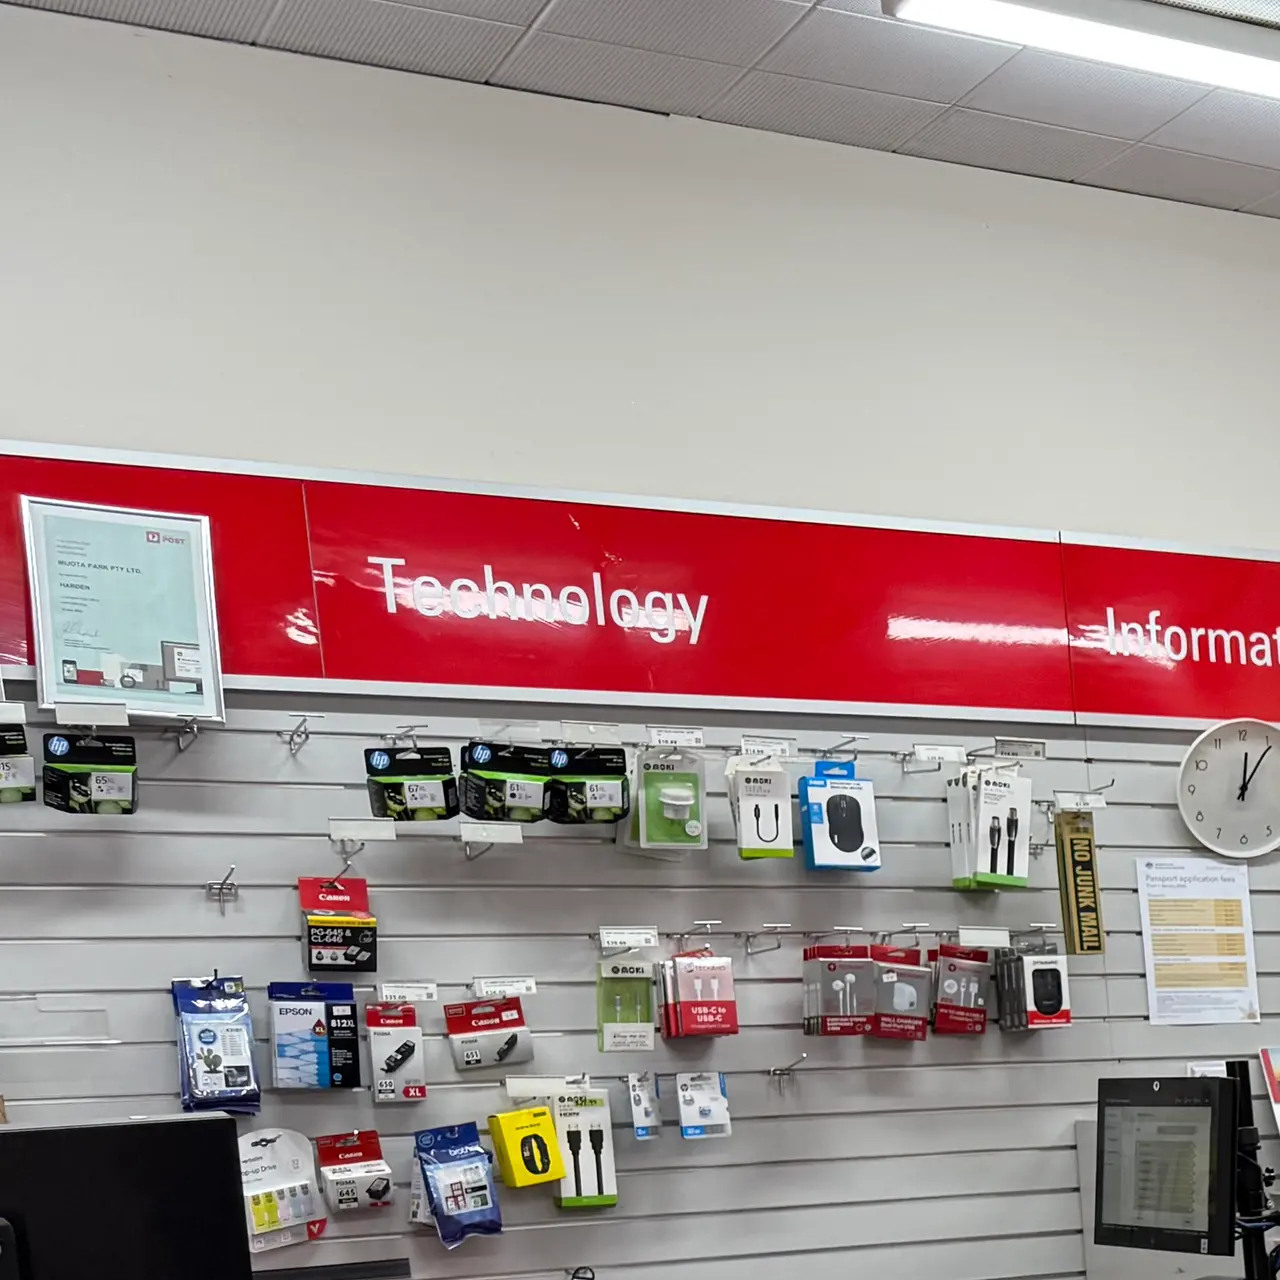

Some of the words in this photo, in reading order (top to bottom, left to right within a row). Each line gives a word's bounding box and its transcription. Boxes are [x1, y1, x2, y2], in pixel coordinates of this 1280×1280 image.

[367, 555, 709, 645] Technology
[1238, 730, 1248, 742] 12
[1265, 735, 1270, 745] 1
[1214, 738, 1222, 750] 11
[1195, 760, 1208, 772] 10
[1188, 784, 1195, 796] 9
[1195, 811, 1204, 822] 8
[1216, 827, 1222, 839] 7
[1266, 825, 1272, 837] 5
[1239, 834, 1248, 845] 6
[1072, 838, 1092, 861] NO
[1146, 874, 1177, 883] Passport
[1179, 874, 1218, 884] application
[1220, 874, 1235, 882] fees
[1075, 863, 1096, 910] JUNK
[318, 892, 350, 902] Canon
[1079, 911, 1100, 952] MAIL
[279, 1007, 312, 1016] EPSON
[380, 1017, 404, 1025] Canon
[464, 1050, 479, 1059] 651
[378, 1080, 394, 1089] 650
[408, 1086, 422, 1096] XL
[338, 1188, 356, 1198] 645
